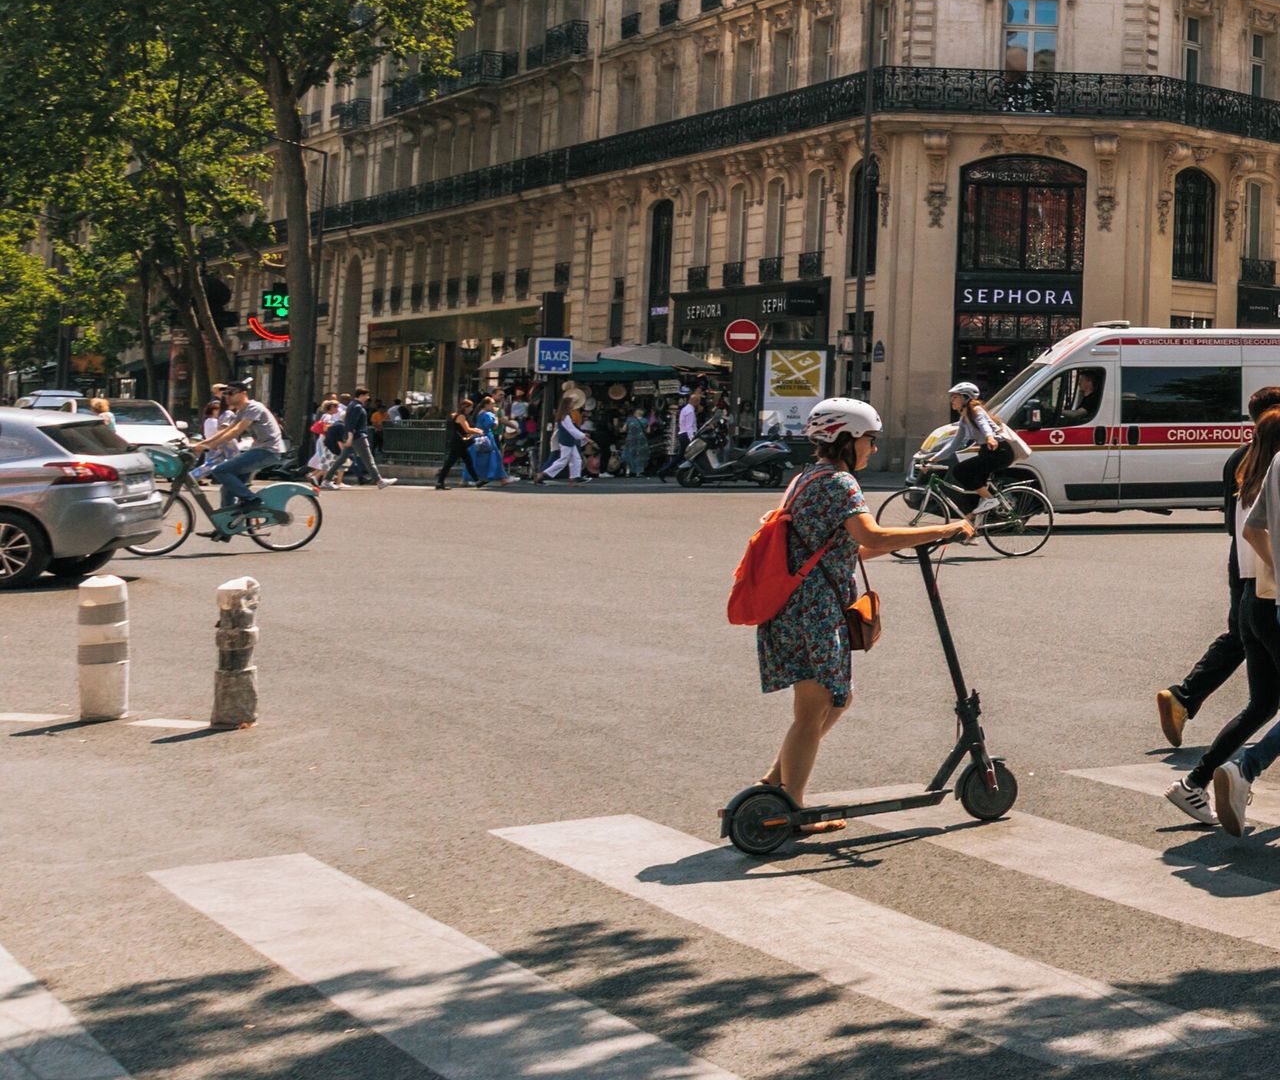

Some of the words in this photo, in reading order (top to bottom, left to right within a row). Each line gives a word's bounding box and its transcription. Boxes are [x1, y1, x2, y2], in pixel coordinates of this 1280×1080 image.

[963, 288, 1074, 305] SEPHORA
[686, 303, 721, 319] SEPHORA
[762, 298, 787, 314] SEPH
[540, 350, 569, 361] TAXIS
[1167, 429, 1253, 440] CROIX-ROUG
